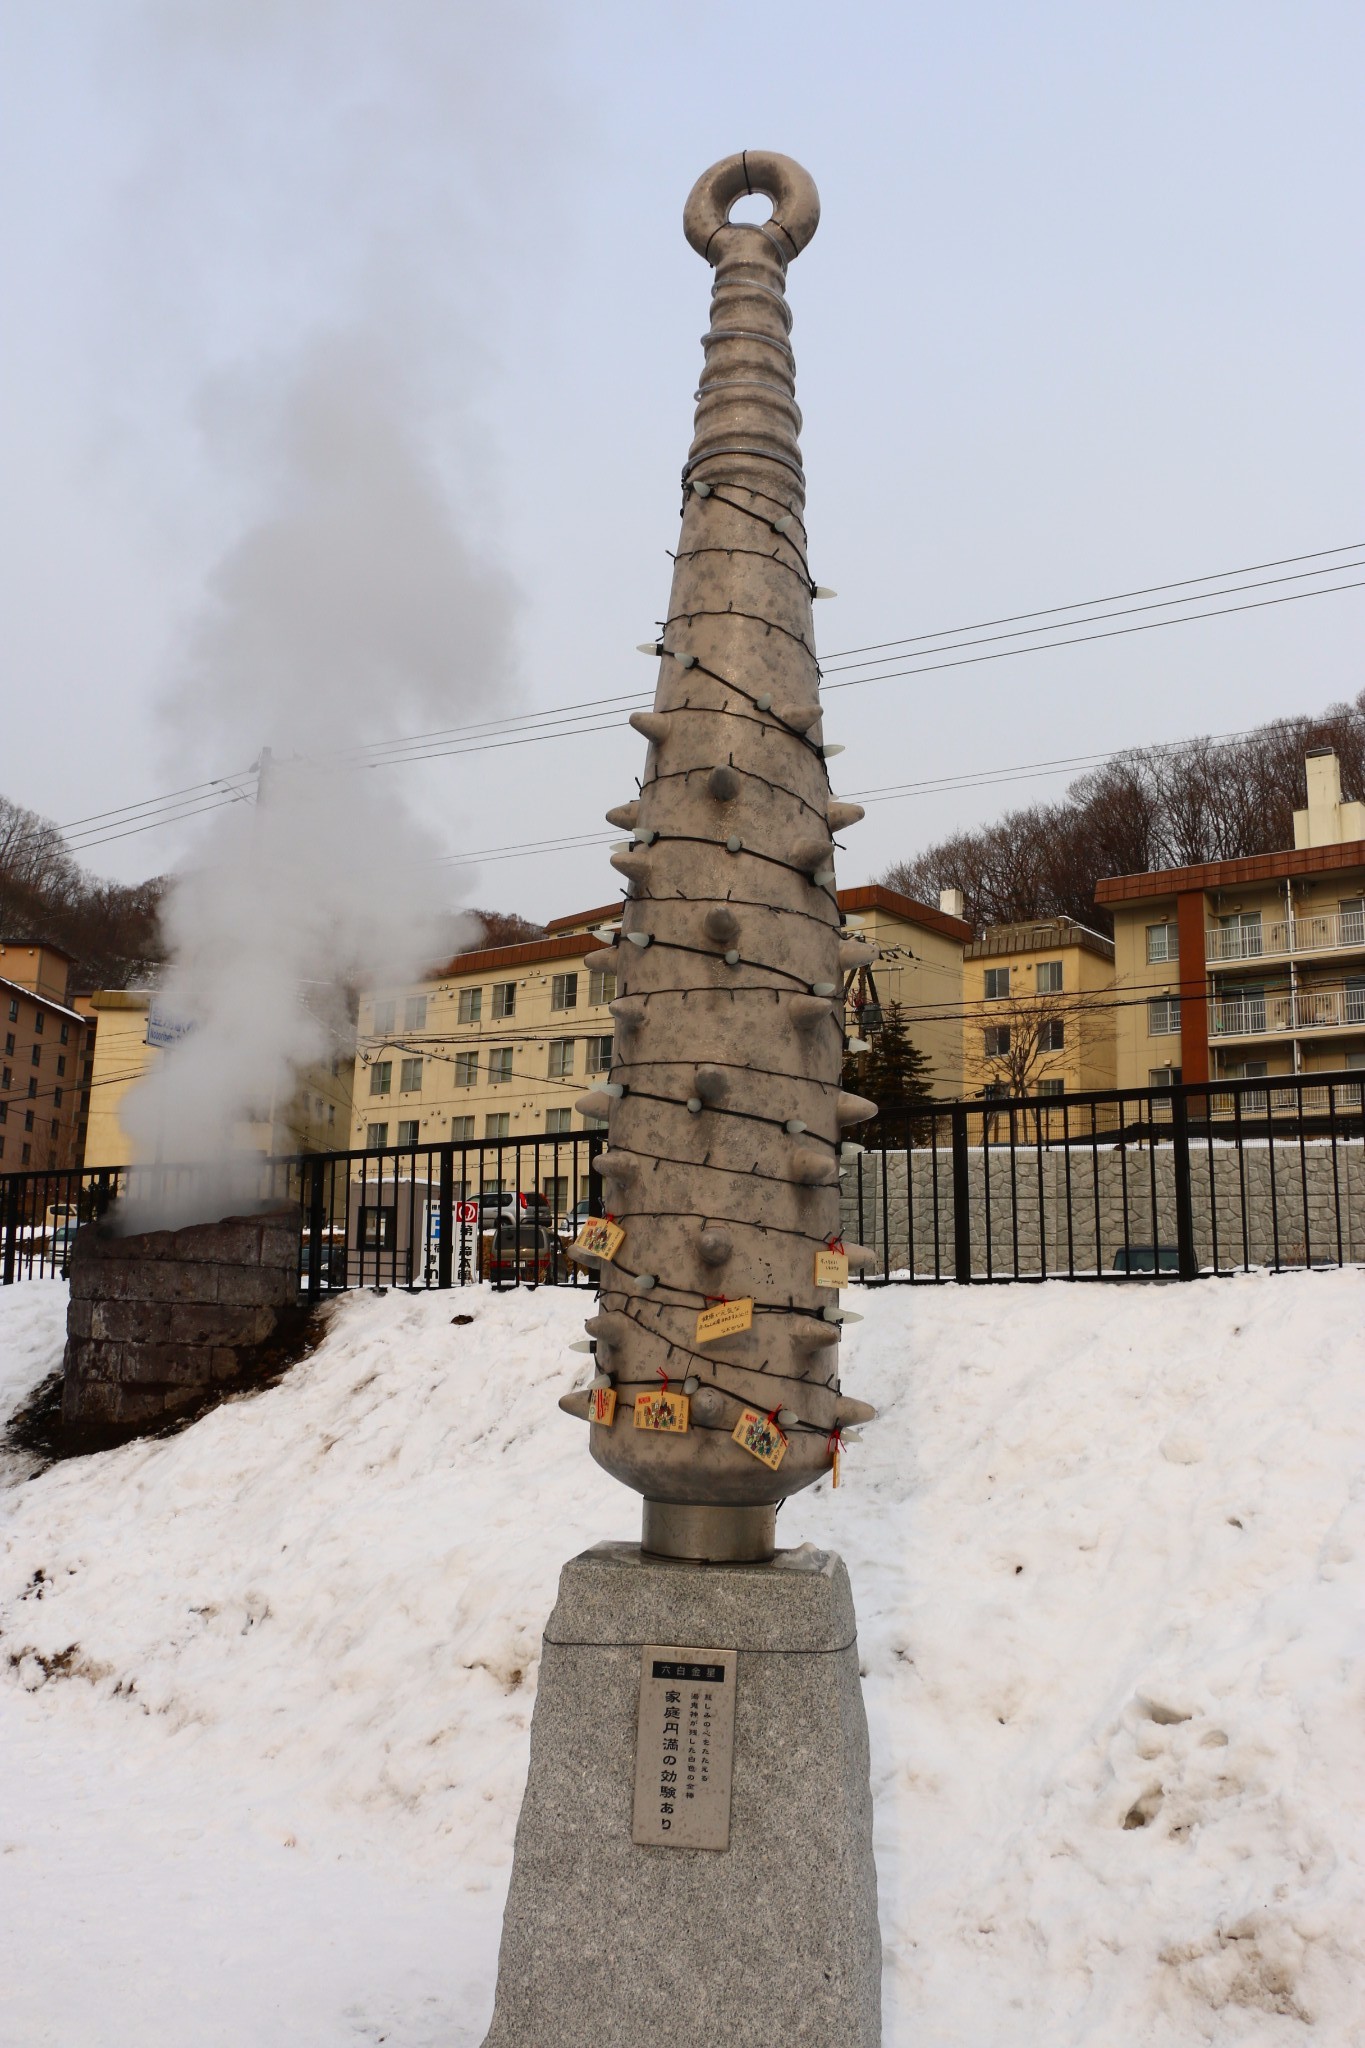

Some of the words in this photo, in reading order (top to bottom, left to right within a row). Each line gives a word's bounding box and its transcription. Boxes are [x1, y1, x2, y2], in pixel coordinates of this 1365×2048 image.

[661, 1665, 716, 1678] 六白金星
[660, 1690, 681, 1830] 家庭円満の効験あり
